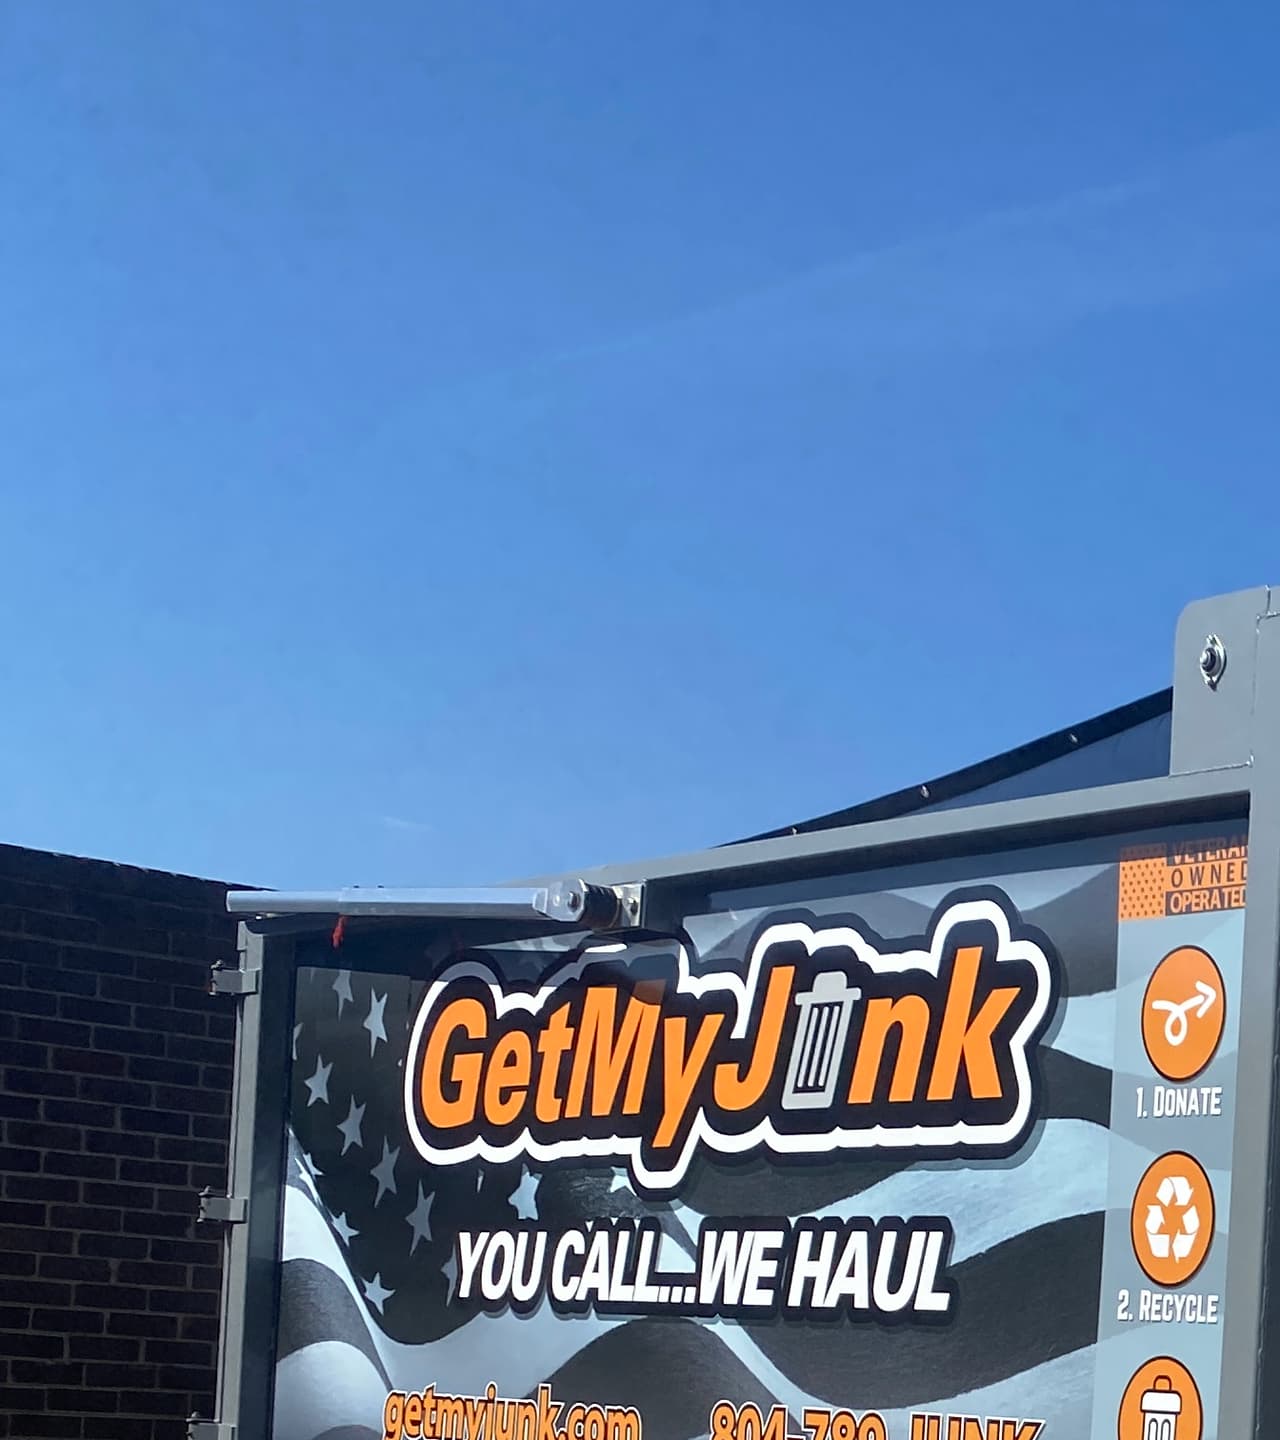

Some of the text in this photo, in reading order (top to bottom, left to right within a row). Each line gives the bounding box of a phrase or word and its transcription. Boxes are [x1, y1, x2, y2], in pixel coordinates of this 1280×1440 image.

[419, 946, 1021, 1149] GetMyJnk
[1136, 1086, 1223, 1118] 1. DONATE
[457, 1230, 547, 1301] YOU
[787, 1230, 951, 1312] HAUL
[1117, 1289, 1219, 1323] 2. RECYCLE
